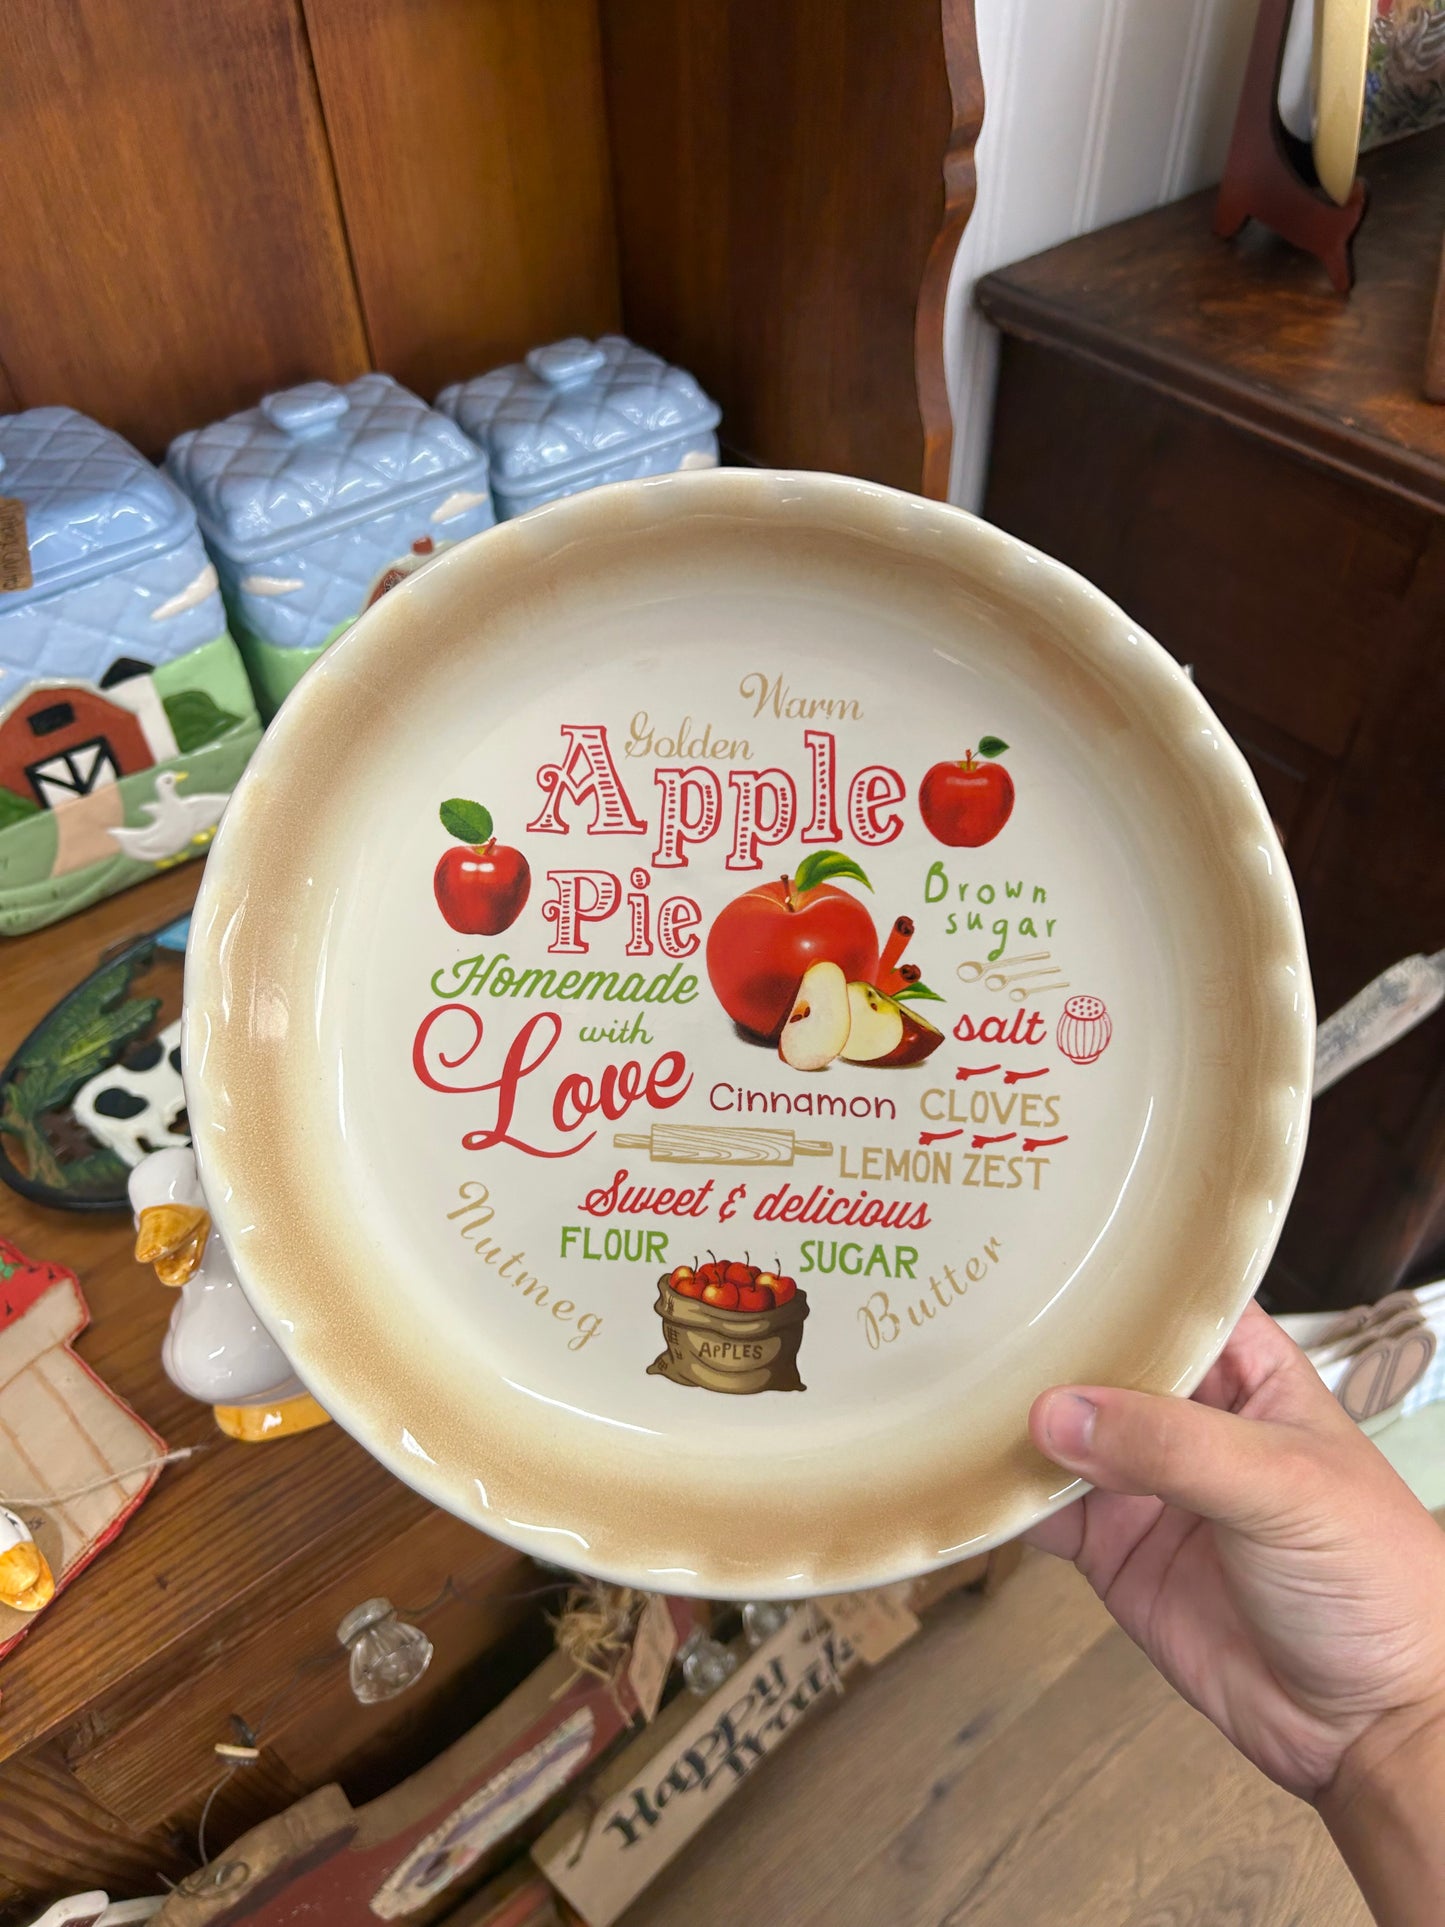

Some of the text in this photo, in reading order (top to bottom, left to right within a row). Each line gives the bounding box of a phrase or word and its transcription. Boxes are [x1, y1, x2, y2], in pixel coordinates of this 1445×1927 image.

[739, 671, 864, 721] Warm
[624, 711, 754, 760] Golden
[526, 724, 906, 871] Apple
[924, 861, 1047, 904] Brown
[541, 867, 702, 959] Pie
[945, 910, 1057, 962] sugar
[430, 953, 700, 1005] Homemade
[578, 1011, 654, 1045] with
[952, 1008, 1048, 1046] salt
[412, 1003, 694, 1159] Love
[709, 1082, 897, 1120] Cinnamon
[919, 1088, 1061, 1128] CLOVES
[838, 1145, 1051, 1191] LEMON ZEST
[577, 1168, 932, 1230] Sweet & delicious
[446, 1181, 604, 1352] Nutmeg
[560, 1226, 669, 1264] FLOUR
[799, 1240, 919, 1279] SUGAR
[857, 1235, 1003, 1350] Butter
[698, 1342, 764, 1361] APPLES
[604, 1655, 789, 1850] Happy
